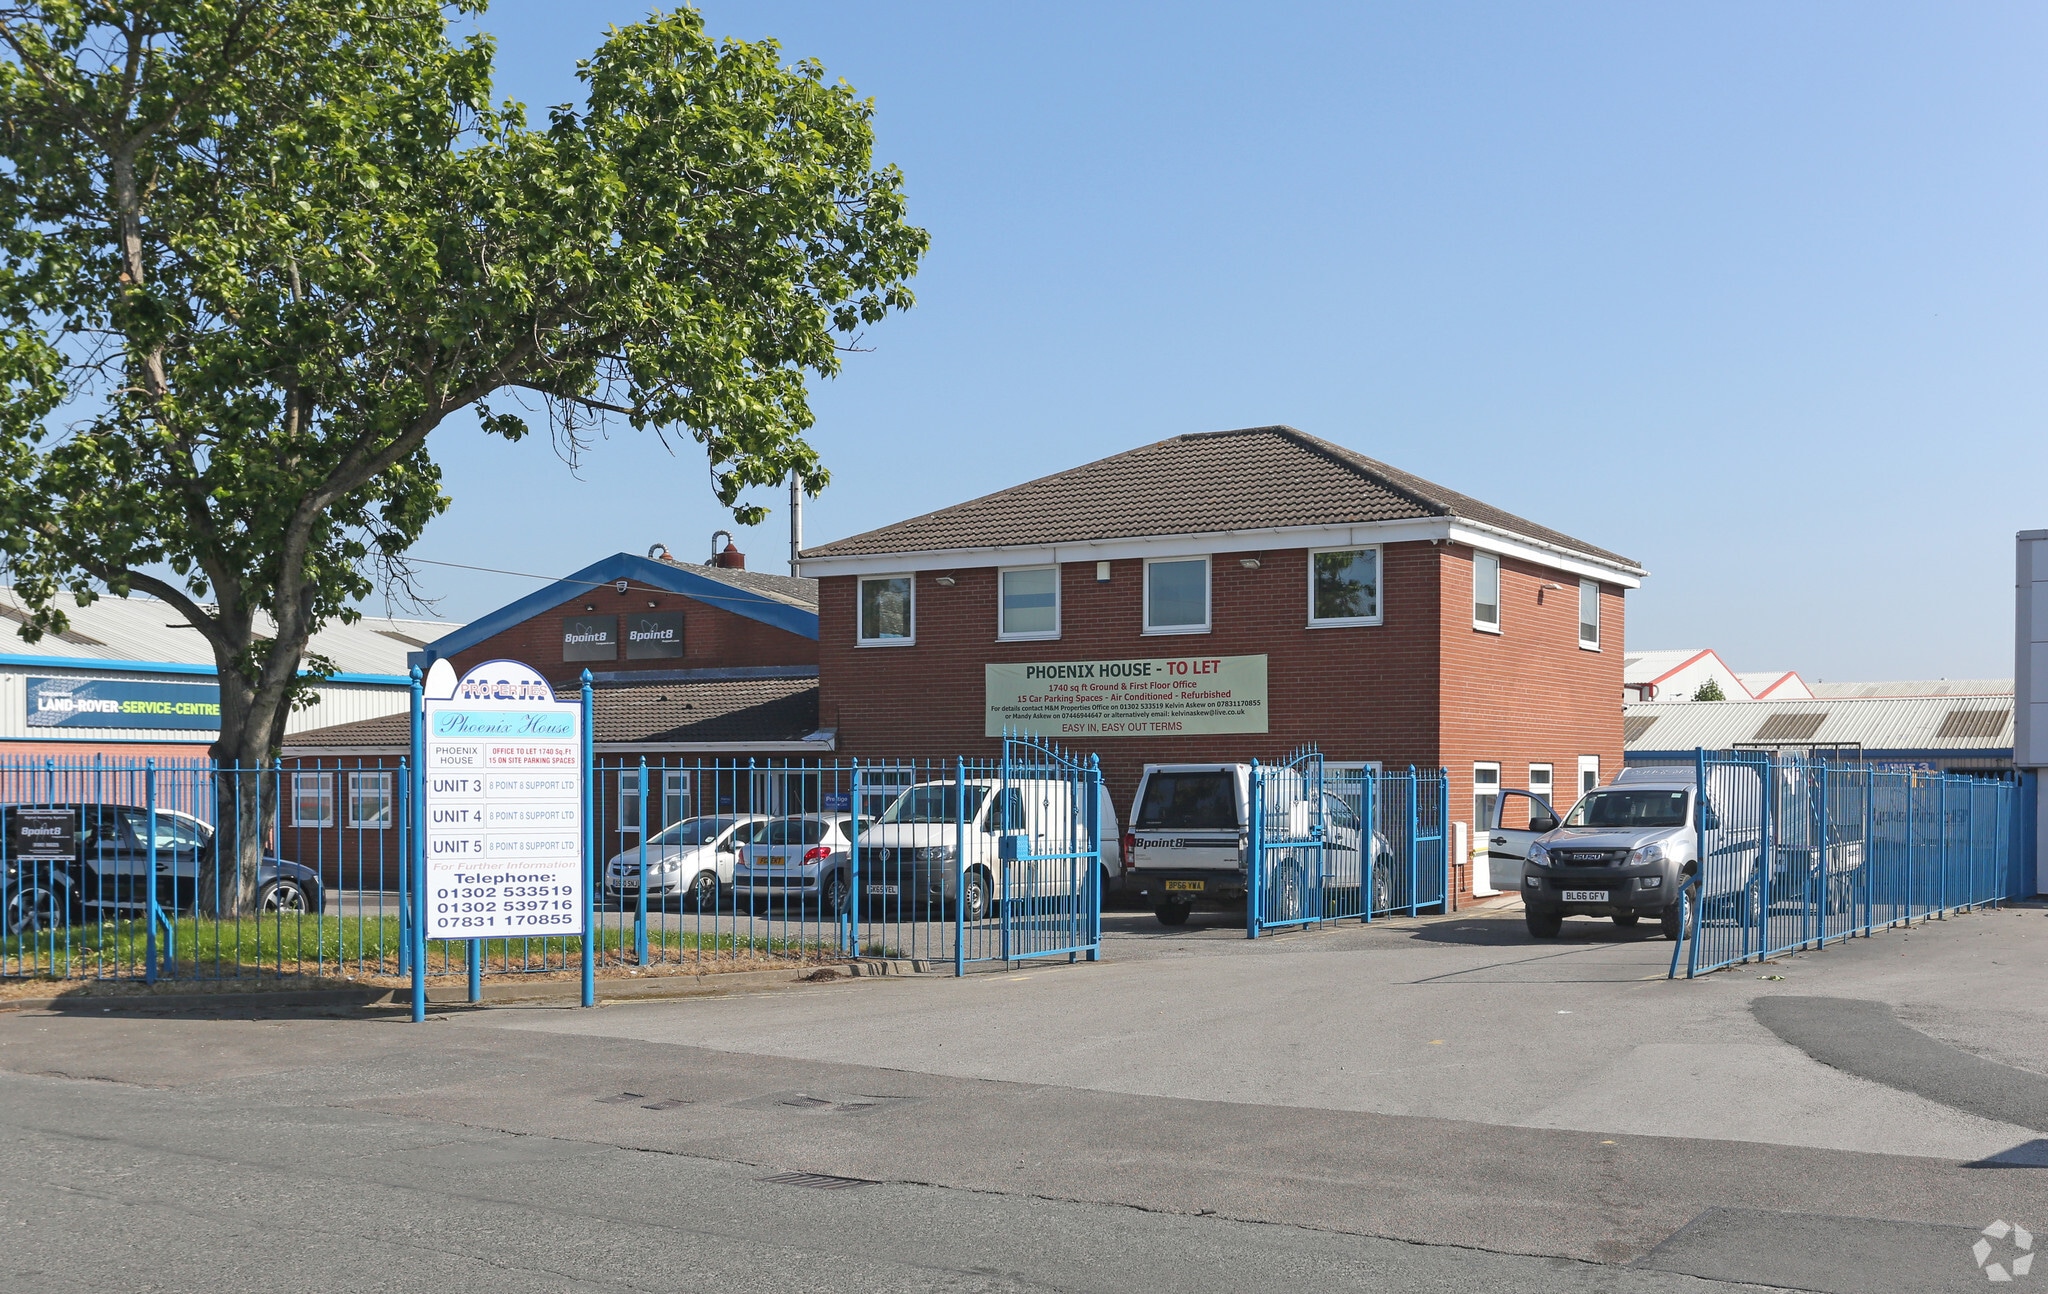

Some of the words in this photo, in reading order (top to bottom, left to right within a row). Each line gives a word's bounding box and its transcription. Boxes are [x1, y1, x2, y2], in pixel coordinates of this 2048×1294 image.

[565, 632, 607, 644] 8point8
[630, 629, 673, 641] 8point8
[1026, 665, 1095, 679] PHOENIX
[1099, 663, 1151, 677] HOUSE
[1167, 661, 1188, 675] TO
[1193, 660, 1221, 674] LET
[460, 683, 548, 696] PROPERTIES
[1049, 684, 1067, 692] 1740
[1070, 685, 1079, 693] sq
[1090, 683, 1118, 691] Ground
[1130, 682, 1148, 690] First
[1150, 681, 1170, 689] Floor
[1173, 680, 1197, 689] Office
[1018, 695, 1027, 703] 15
[1029, 695, 1042, 703] Car
[1044, 694, 1074, 704] Parking
[1076, 694, 1103, 703] Spaces
[1124, 692, 1173, 701] Conditioned
[1181, 690, 1231, 699] Refurbished
[1060, 704, 1091, 713] Properties
[1216, 700, 1261, 708] 07831170855
[1111, 711, 1149, 719] alternatively
[1171, 709, 1245, 717] kelvinaskew@live.co.uk
[440, 712, 512, 733] Phoenix
[517, 713, 570, 734] House
[1062, 723, 1085, 732] EASY
[1087, 723, 1099, 733] IN,
[1101, 723, 1125, 732] EASY
[1128, 722, 1148, 731] OUT
[1149, 722, 1183, 731] TERMS
[435, 747, 478, 755] PHOENIX
[555, 748, 572, 756] Sq.Ft
[1919, 763, 1929, 772] 3
[433, 779, 469, 792] UNIT
[473, 779, 482, 792] 3
[489, 782, 494, 790] 8
[495, 781, 518, 790] POINT
[519, 781, 524, 790] 8
[525, 781, 560, 790] SUPPORT
[561, 781, 575, 789] LTD
[433, 810, 469, 823] UNIT
[473, 810, 482, 823] 4
[489, 812, 494, 820] 8
[495, 811, 518, 820] POINT
[519, 811, 524, 820] 8
[525, 811, 560, 820] SUPPORT
[561, 811, 575, 819] LTD
[21, 827, 61, 837] 8point8
[433, 840, 469, 853] UNIT
[473, 840, 482, 853] 5
[489, 843, 494, 851] 8
[495, 842, 518, 851] POINT
[519, 842, 524, 851] 8
[525, 842, 560, 851] SUPPORT
[561, 842, 575, 850] LTD
[1136, 838, 1184, 849] 8point8
[457, 862, 503, 870] Further
[507, 861, 576, 870] Information
[454, 873, 556, 885] Telephone:
[437, 887, 496, 899] 01302
[503, 886, 572, 897] 533519
[1566, 892, 1587, 900] BL66
[1589, 892, 1605, 900] GFV
[437, 902, 496, 913] 01302
[503, 900, 572, 912] 539716
[437, 917, 494, 928] 07831
[504, 914, 572, 926] 170855
